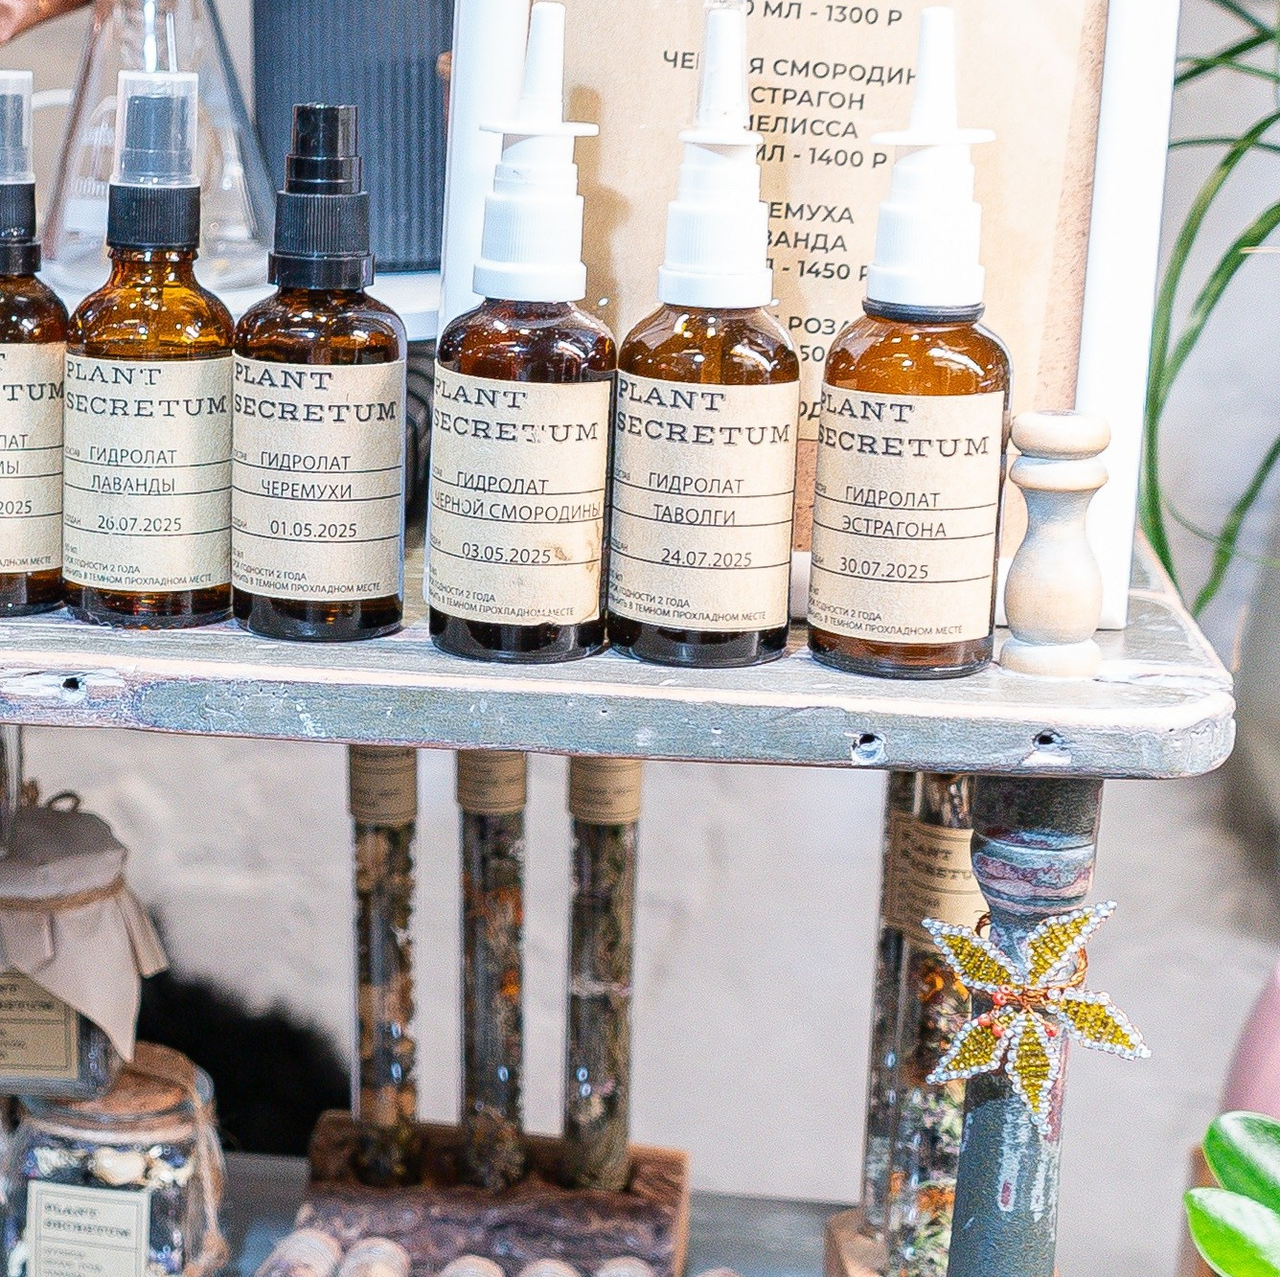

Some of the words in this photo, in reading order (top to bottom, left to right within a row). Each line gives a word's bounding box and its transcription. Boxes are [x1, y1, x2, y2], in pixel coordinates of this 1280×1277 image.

[763, 0, 802, 19] МЛ
[826, 5, 879, 25] 1300
[887, 10, 903, 26] Р
[750, 86, 865, 110] СТРАГОН
[808, 147, 864, 167] 1400
[872, 152, 888, 169] Р
[770, 201, 855, 224] ЕМУХА
[798, 260, 851, 280] 1450
[66, 359, 161, 385] PLANT
[235, 362, 333, 390] PLANT
[65, 392, 227, 417] SECRETUM
[434, 377, 527, 409] PLANT
[619, 378, 725, 411] PLANT
[234, 393, 397, 422] SECRETUM
[821, 390, 914, 423] PLANT
[433, 411, 598, 442] SECRETUM
[616, 411, 790, 445] SECRETUM
[819, 424, 989, 457] SECRETUM
[89, 446, 178, 466] ГИДРОЛАТ
[261, 451, 352, 471] ГИДРОЛАТ
[91, 474, 176, 495] ЛАВАНДЫ
[261, 479, 353, 499] ЧЕРЕМУХИ
[456, 471, 549, 494] ГИДРОЛАТ
[648, 472, 745, 494] ГИДРОЛАТ
[434, 490, 485, 518] ЧЕРНОЙ
[489, 502, 601, 521] СМОРОДИНЫ
[845, 485, 941, 508] ГИДРОЛАТ
[653, 503, 736, 526] ТАВОЛГИ
[270, 520, 357, 538] 01.05.2025
[842, 515, 948, 538] ЭСТРАГОНА
[462, 542, 551, 564] 03.05.2025
[661, 548, 752, 568] 24.07.2025
[839, 556, 929, 580] 30.07.2025
